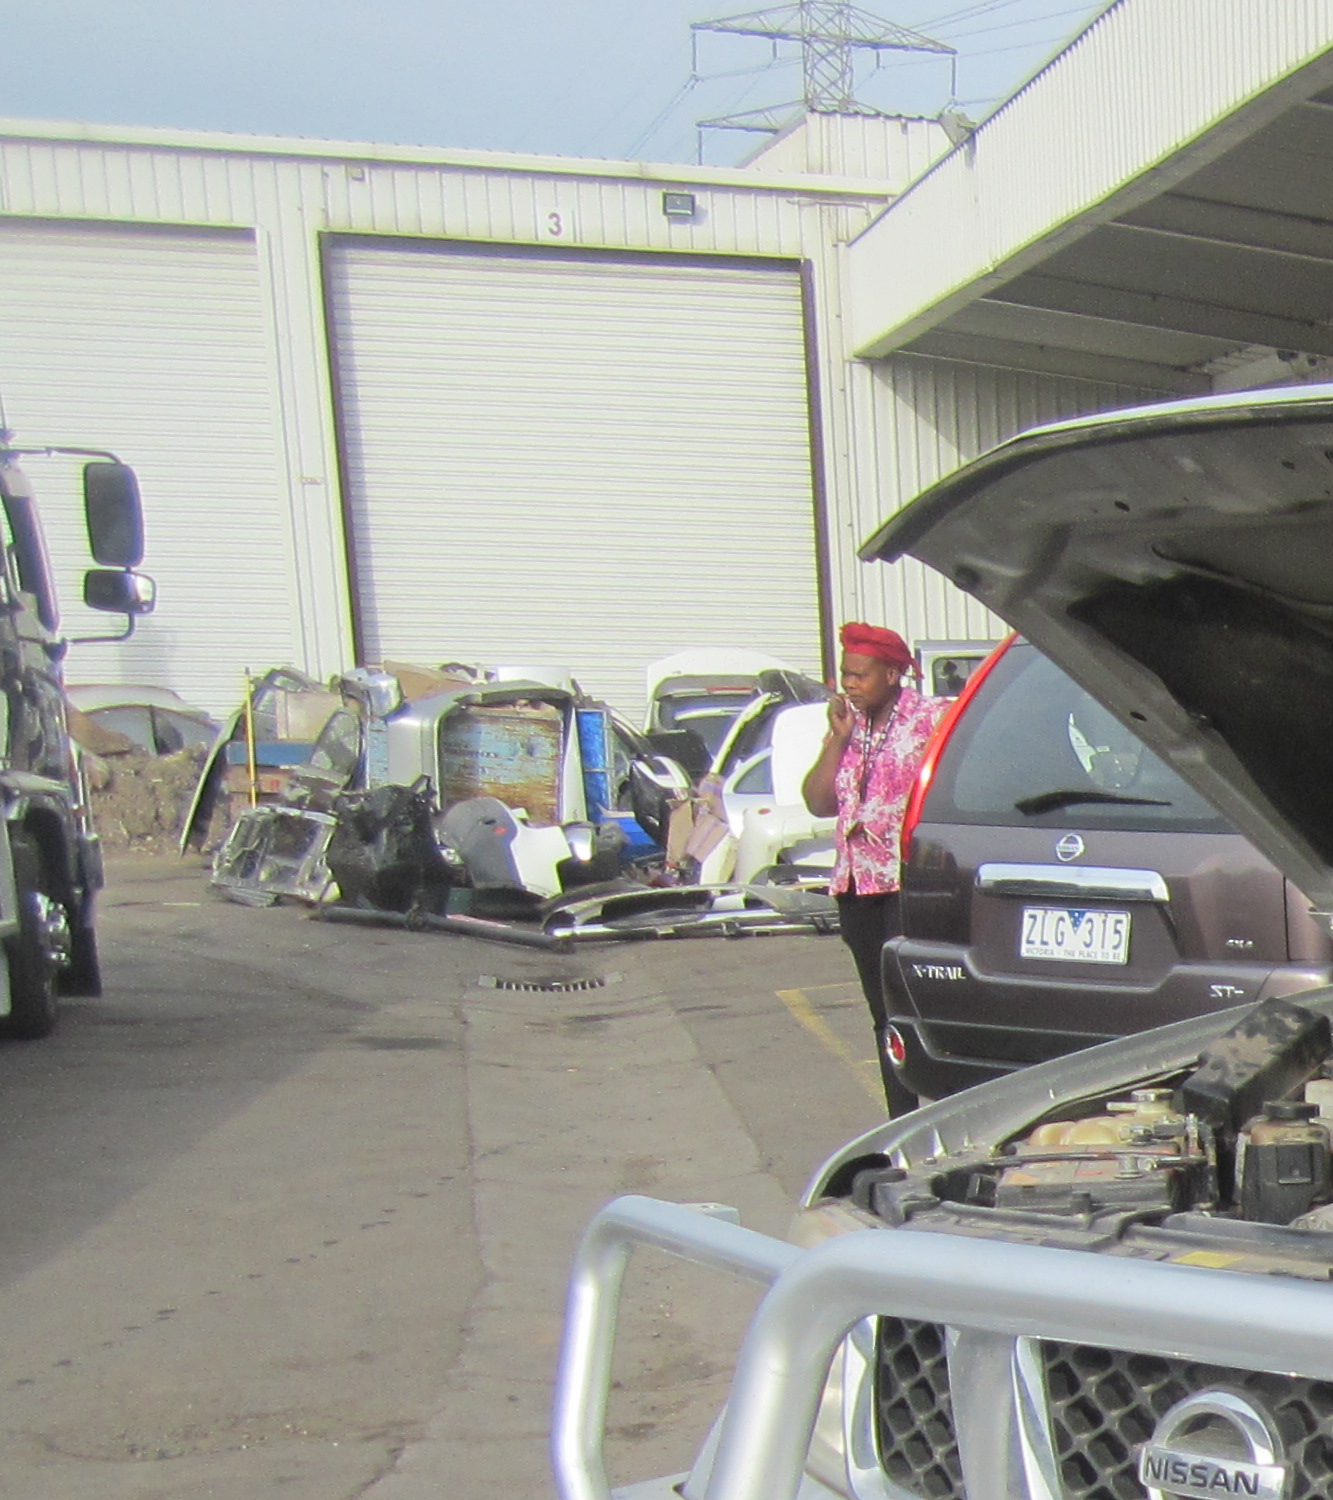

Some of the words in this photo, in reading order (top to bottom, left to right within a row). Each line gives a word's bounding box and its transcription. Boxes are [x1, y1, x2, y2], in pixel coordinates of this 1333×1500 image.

[547, 212, 563, 236] 3
[1025, 914, 1066, 947] ZLG
[1082, 917, 1124, 950] 315
[912, 963, 967, 980] X-TRAIL
[1146, 1456, 1260, 1495] NISSAN
